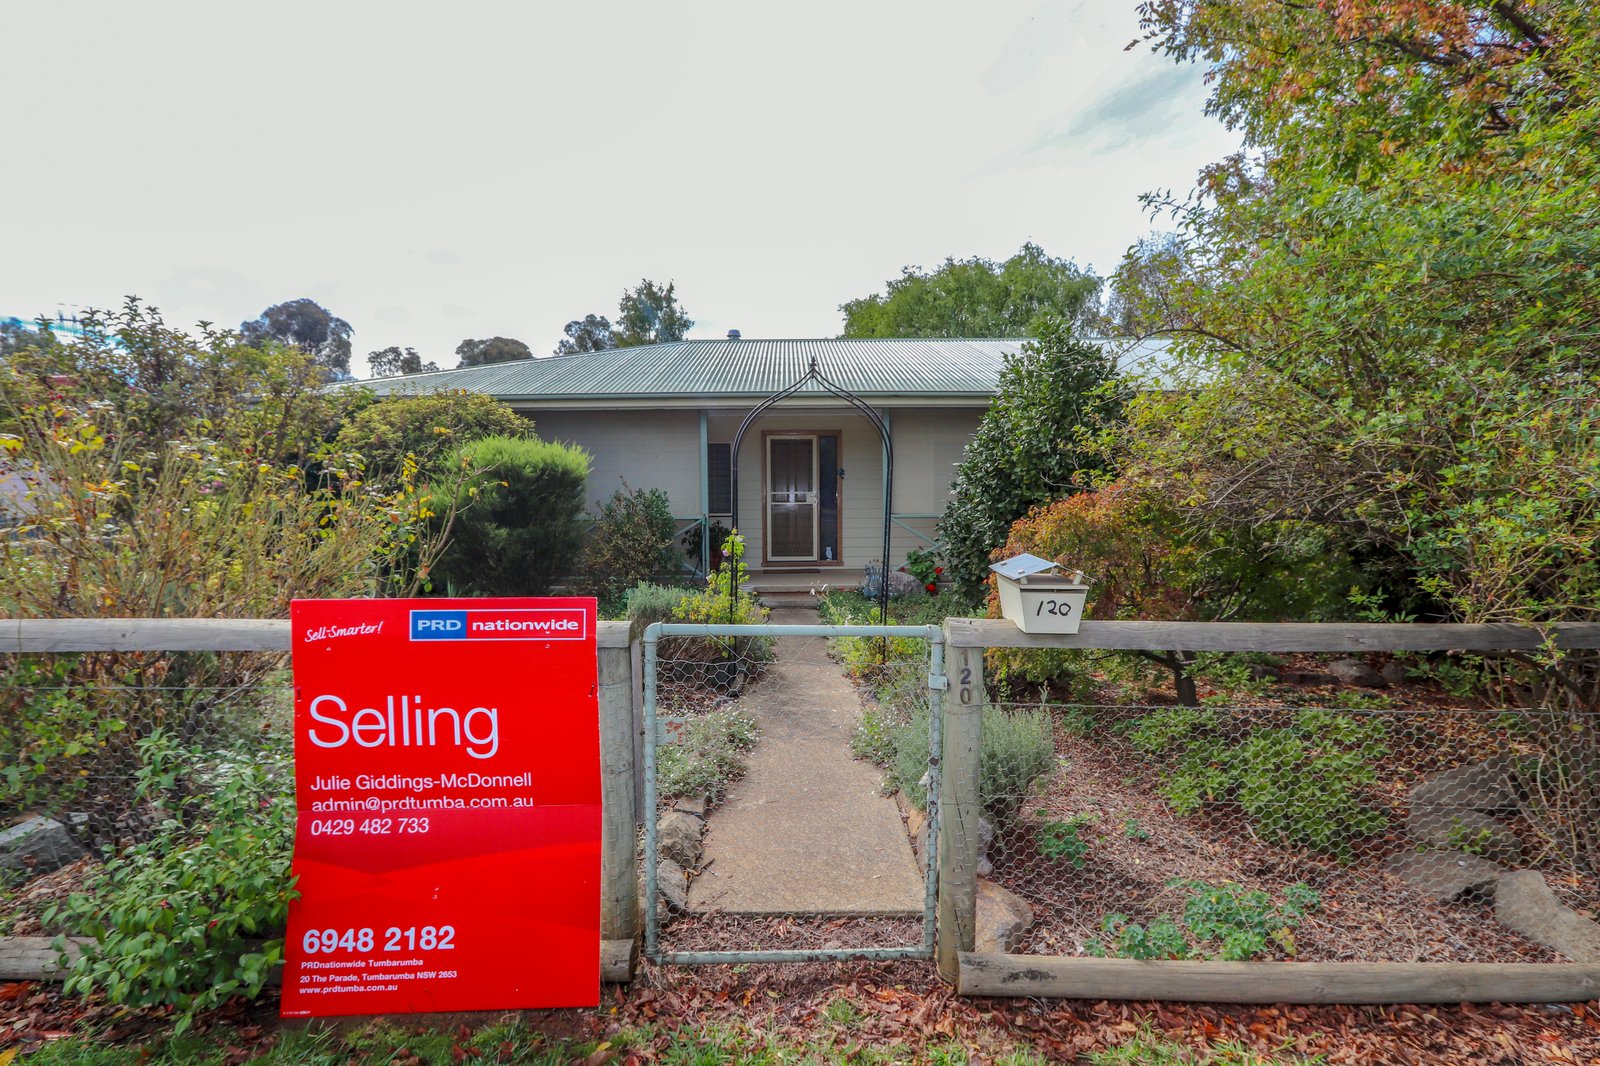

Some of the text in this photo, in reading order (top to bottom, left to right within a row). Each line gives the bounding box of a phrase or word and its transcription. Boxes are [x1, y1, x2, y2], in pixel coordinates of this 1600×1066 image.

[1036, 600, 1071, 616] 120
[417, 618, 579, 631] PRD nationwide
[959, 650, 972, 705] 120
[309, 695, 498, 759] Selling
[311, 772, 531, 792] Julie Giddings-McDonnell
[312, 796, 533, 813] admin@prdtumba.com.au
[311, 818, 429, 835] 0429 482 733
[303, 926, 455, 953] 6948 2182
[301, 958, 424, 970] PRDnationwide Tumbarumba
[300, 970, 458, 983] 20 The Parade, Tumbarumba NSW 2653
[300, 984, 398, 995] www.prdtumba.com.au
